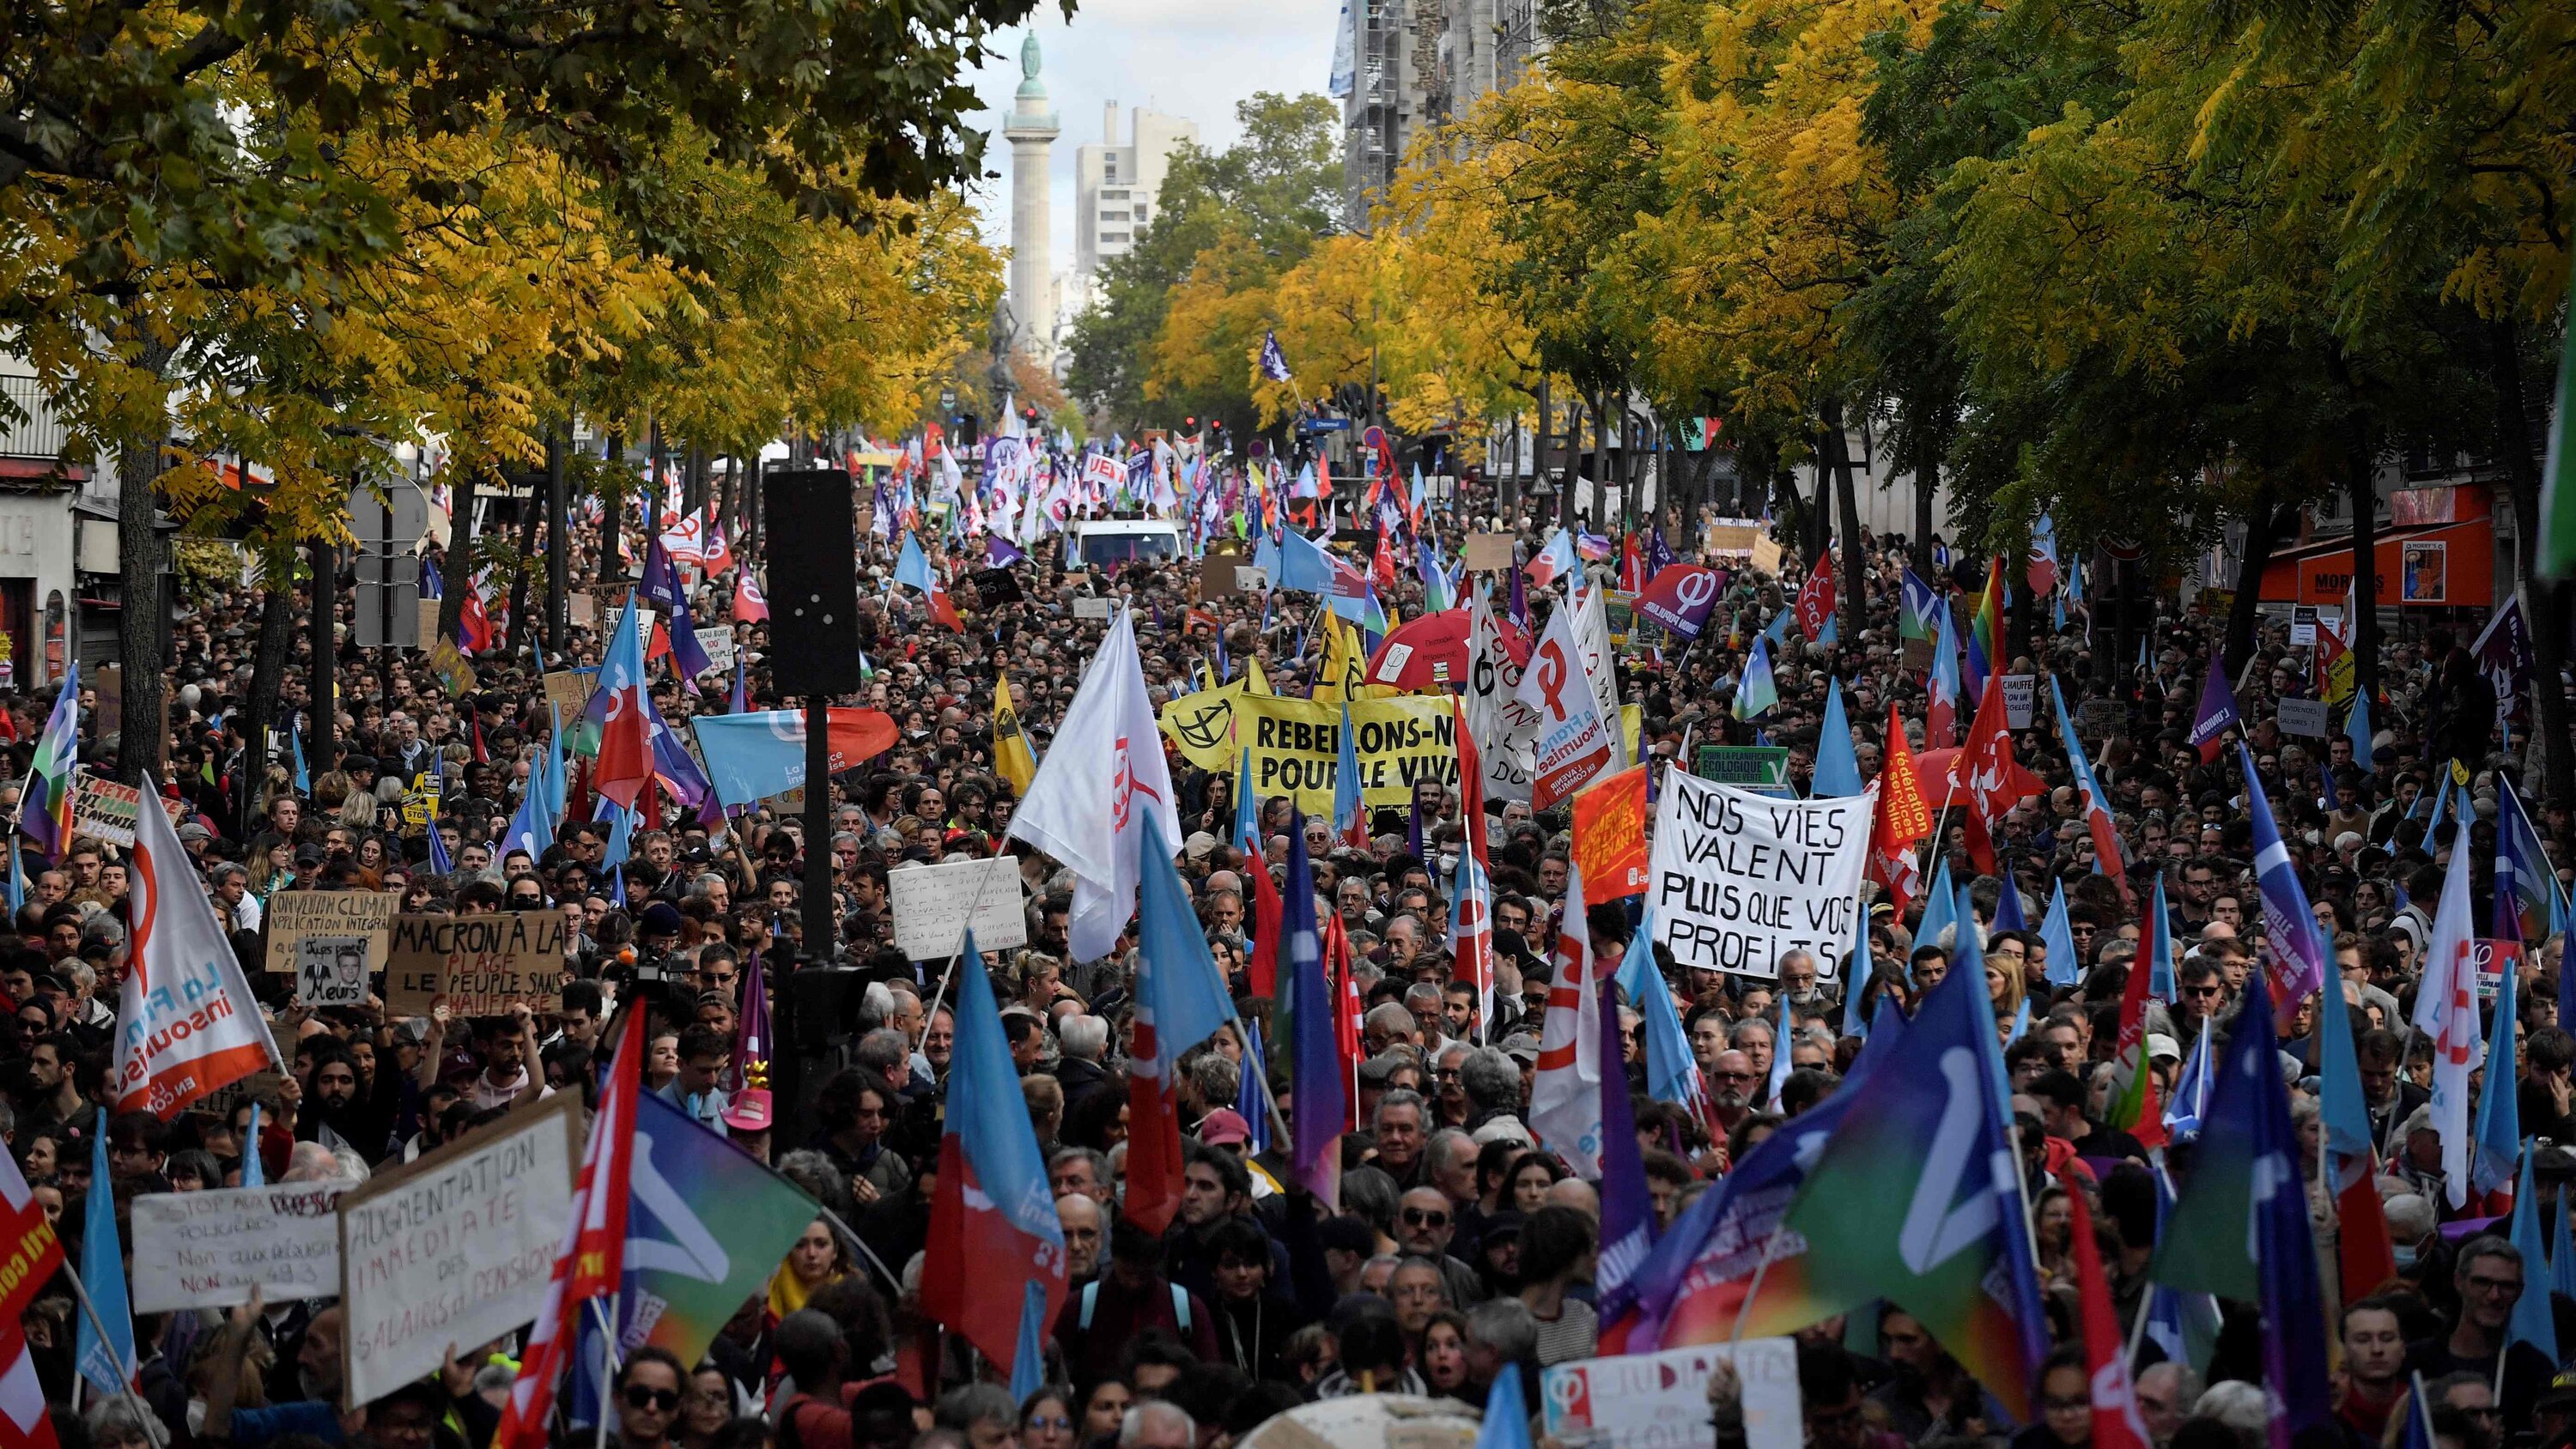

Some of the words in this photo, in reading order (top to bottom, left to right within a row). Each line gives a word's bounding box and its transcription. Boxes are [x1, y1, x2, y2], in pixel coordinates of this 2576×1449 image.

[605, 585, 626, 597] HAUT
[2315, 573, 2385, 589] MORS
[713, 628, 728, 638] BOUT
[708, 649, 732, 658] PEUPLE
[568, 689, 586, 702] PAS
[2002, 679, 2032, 690] CHAUFFE
[2281, 704, 2318, 715] DIVIDENDES
[2280, 717, 2308, 727] SALAIRES
[1257, 714, 1458, 755] REBELONS-N
[1703, 751, 1722, 761] POUR
[1722, 752, 1731, 761] LA
[1732, 752, 1780, 761] PLANIFICATION
[784, 765, 799, 775] La
[1261, 756, 1337, 791] POUR
[1359, 760, 1387, 789] LE
[1398, 755, 1461, 787] VIVA
[77, 791, 100, 809] NI
[776, 789, 805, 804] COMB
[1894, 750, 1929, 834] fédération
[1377, 805, 1413, 816] extinctio
[1888, 770, 1916, 837] services
[88, 809, 137, 831] AVENIR
[1677, 785, 1744, 836] NOS
[1771, 804, 1846, 849] VIES
[82, 820, 136, 846] JEUNES
[1683, 829, 1835, 886] VALENT
[270, 894, 336, 916] CONVENTION
[1662, 871, 1741, 921] PLUS
[1747, 892, 1793, 930] QUE
[1807, 896, 1853, 936] VOS
[270, 916, 341, 932] APPLICATION
[392, 919, 505, 955] MACRON
[538, 920, 567, 955] LA
[447, 952, 516, 979] PLAGE
[307, 977, 361, 1003] Meurs
[404, 973, 436, 993] LE
[450, 973, 523, 995] PEUPLE
[528, 971, 564, 997] SANS
[350, 1133, 537, 1255] AUGMENTATION
[356, 1191, 517, 1293] IMMEDIATE
[179, 1273, 222, 1295] NON
